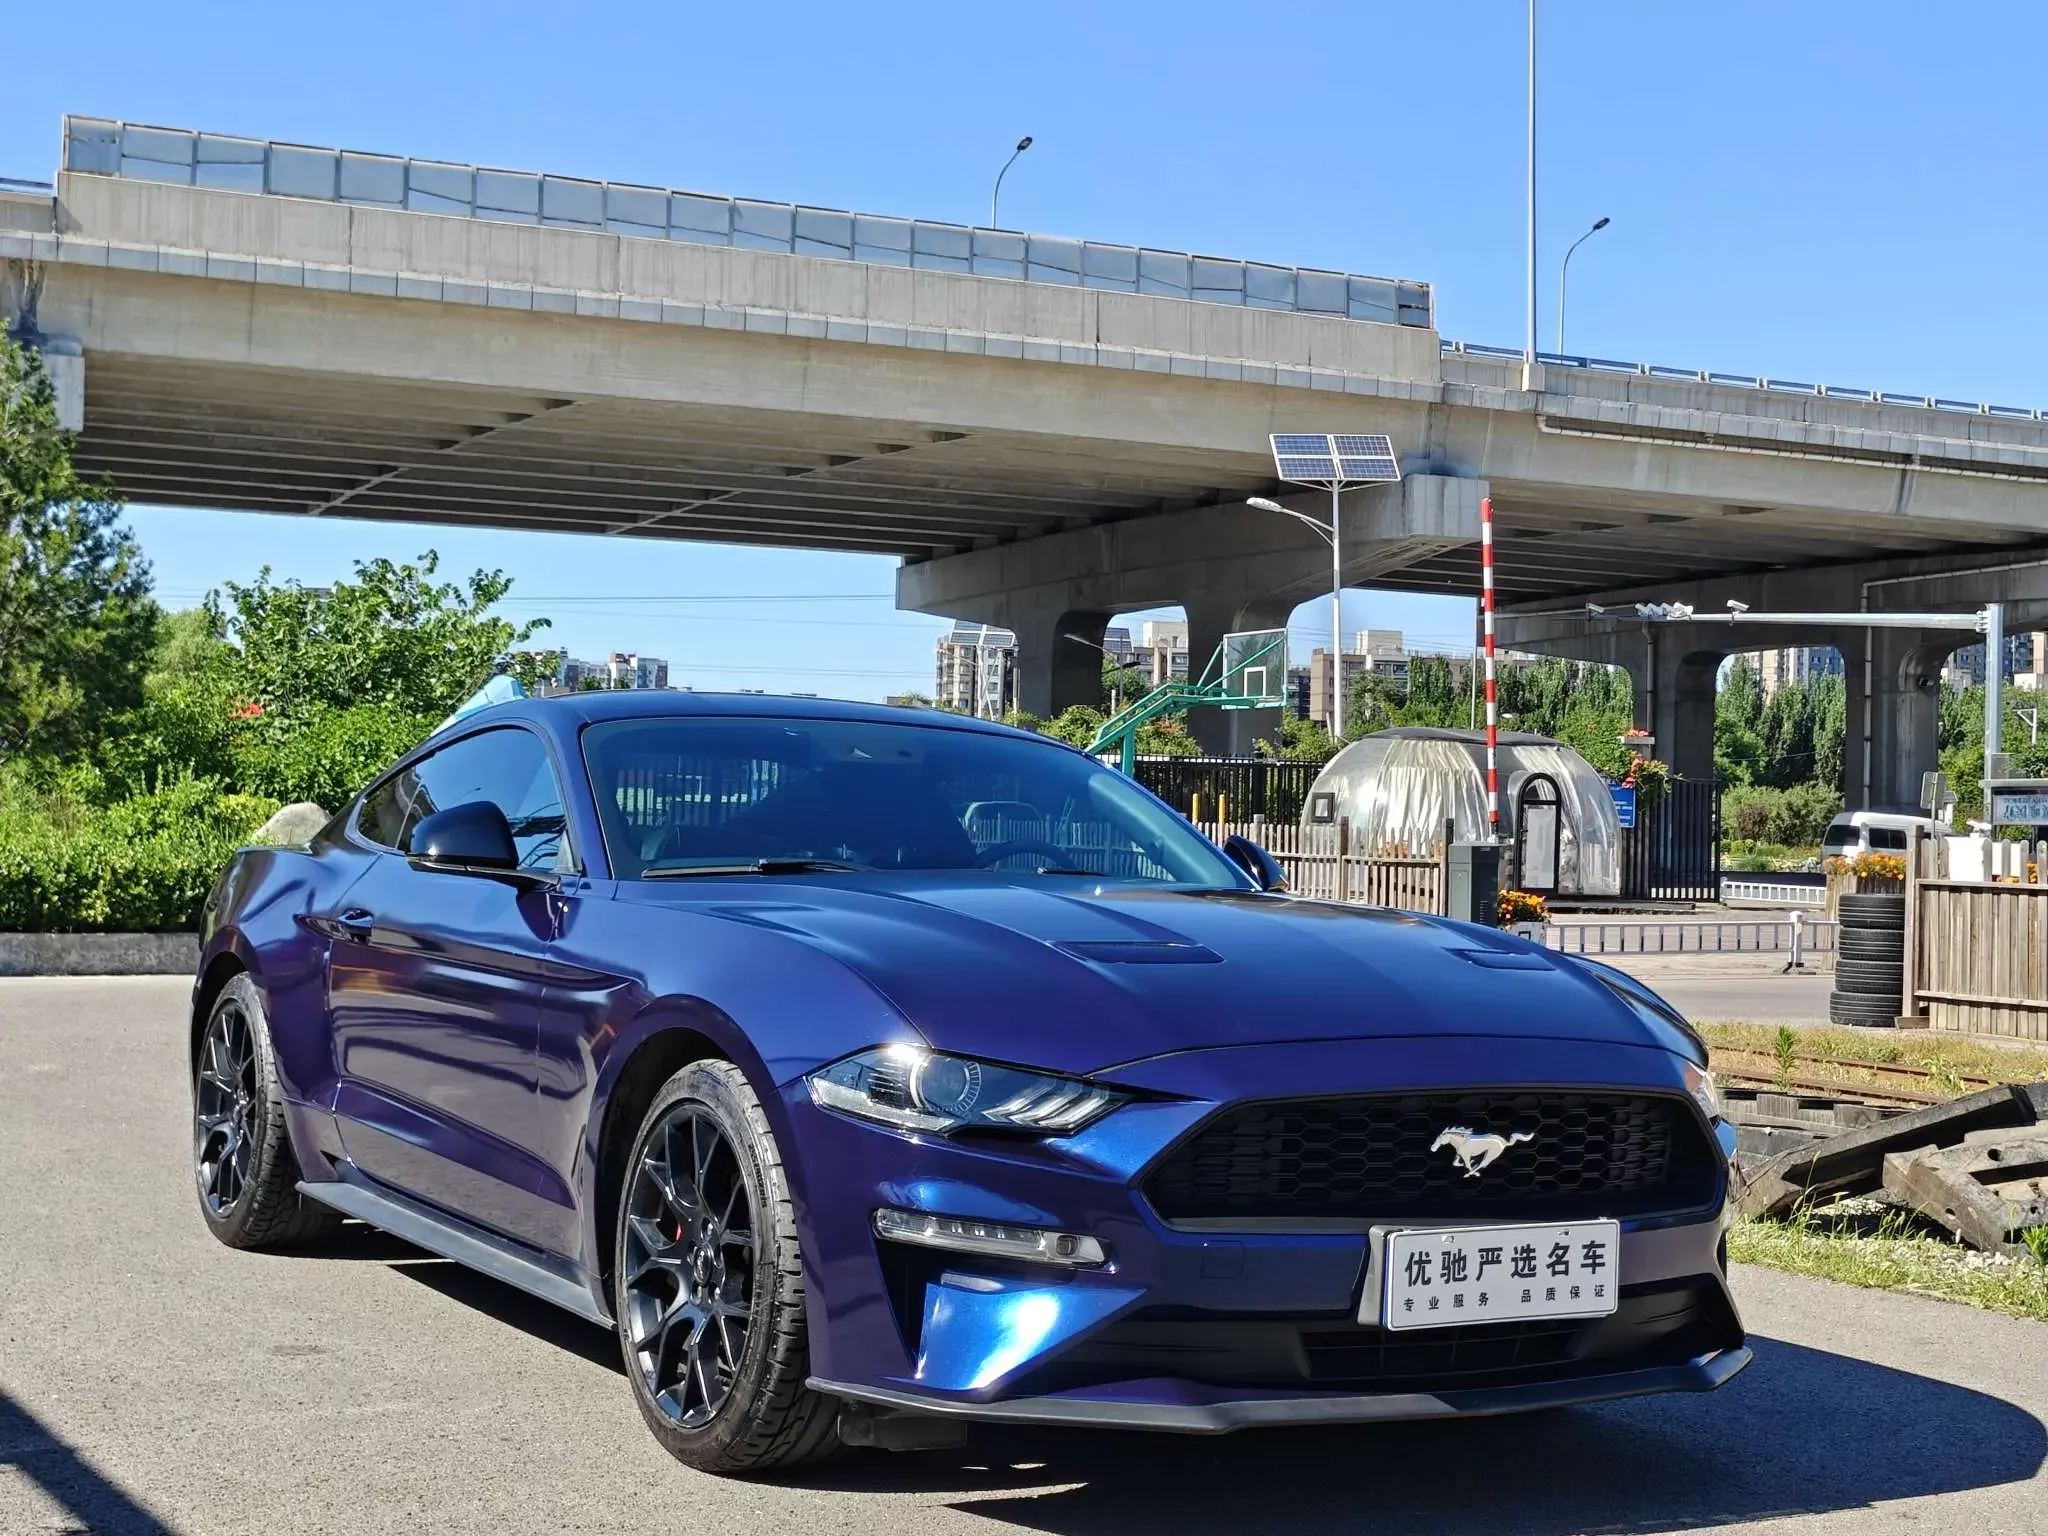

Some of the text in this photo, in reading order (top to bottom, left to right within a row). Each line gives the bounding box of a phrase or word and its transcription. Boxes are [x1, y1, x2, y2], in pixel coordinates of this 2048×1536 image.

[1404, 1240, 1606, 1287] 优驰严选名车
[1403, 1284, 1605, 1311] 专业服务 品质保证
